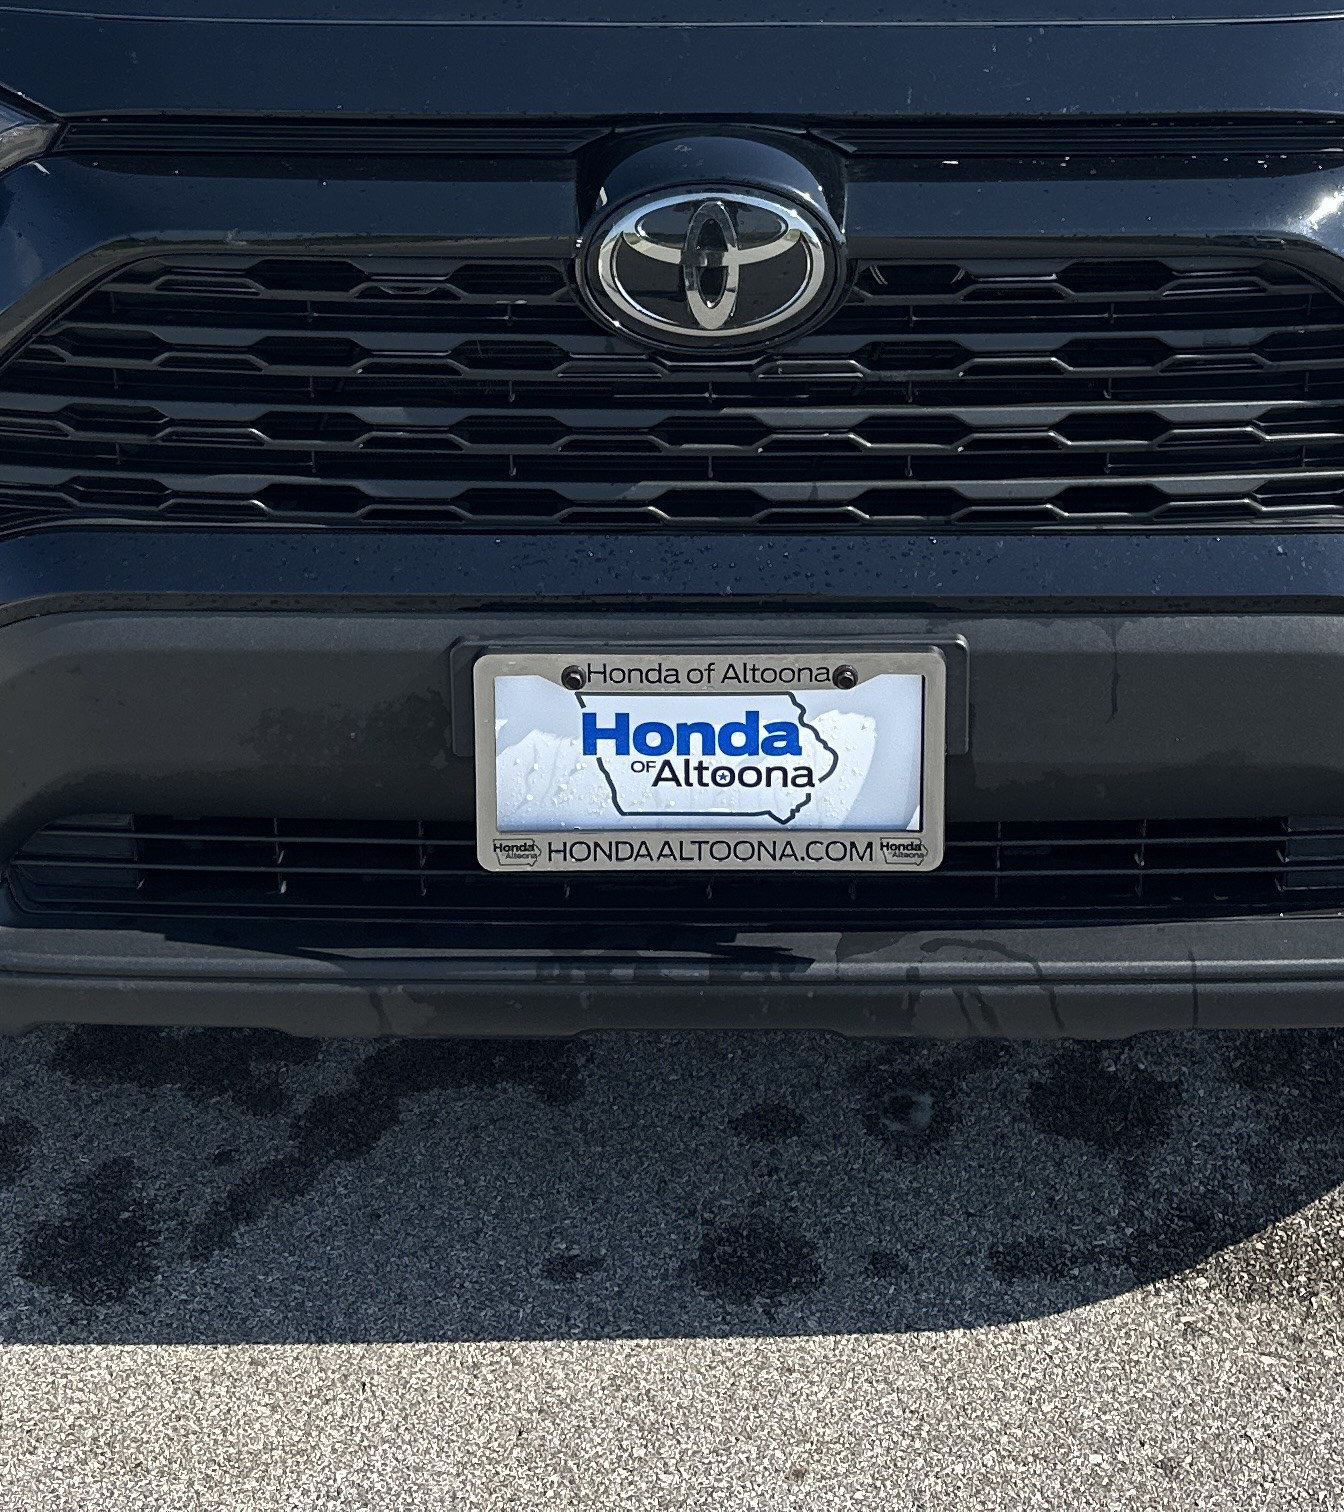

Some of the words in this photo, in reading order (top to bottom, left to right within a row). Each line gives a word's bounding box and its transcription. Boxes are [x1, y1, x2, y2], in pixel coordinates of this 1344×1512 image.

[587, 663, 681, 684] Honda
[686, 662, 716, 684] of
[720, 662, 832, 684] Altoona
[582, 710, 803, 757] Honda
[630, 760, 657, 773] OF
[651, 758, 816, 788] Altoona
[493, 843, 535, 852] Honda
[547, 840, 874, 863] HONDAALTOONA.COM
[880, 841, 922, 851] Honda
